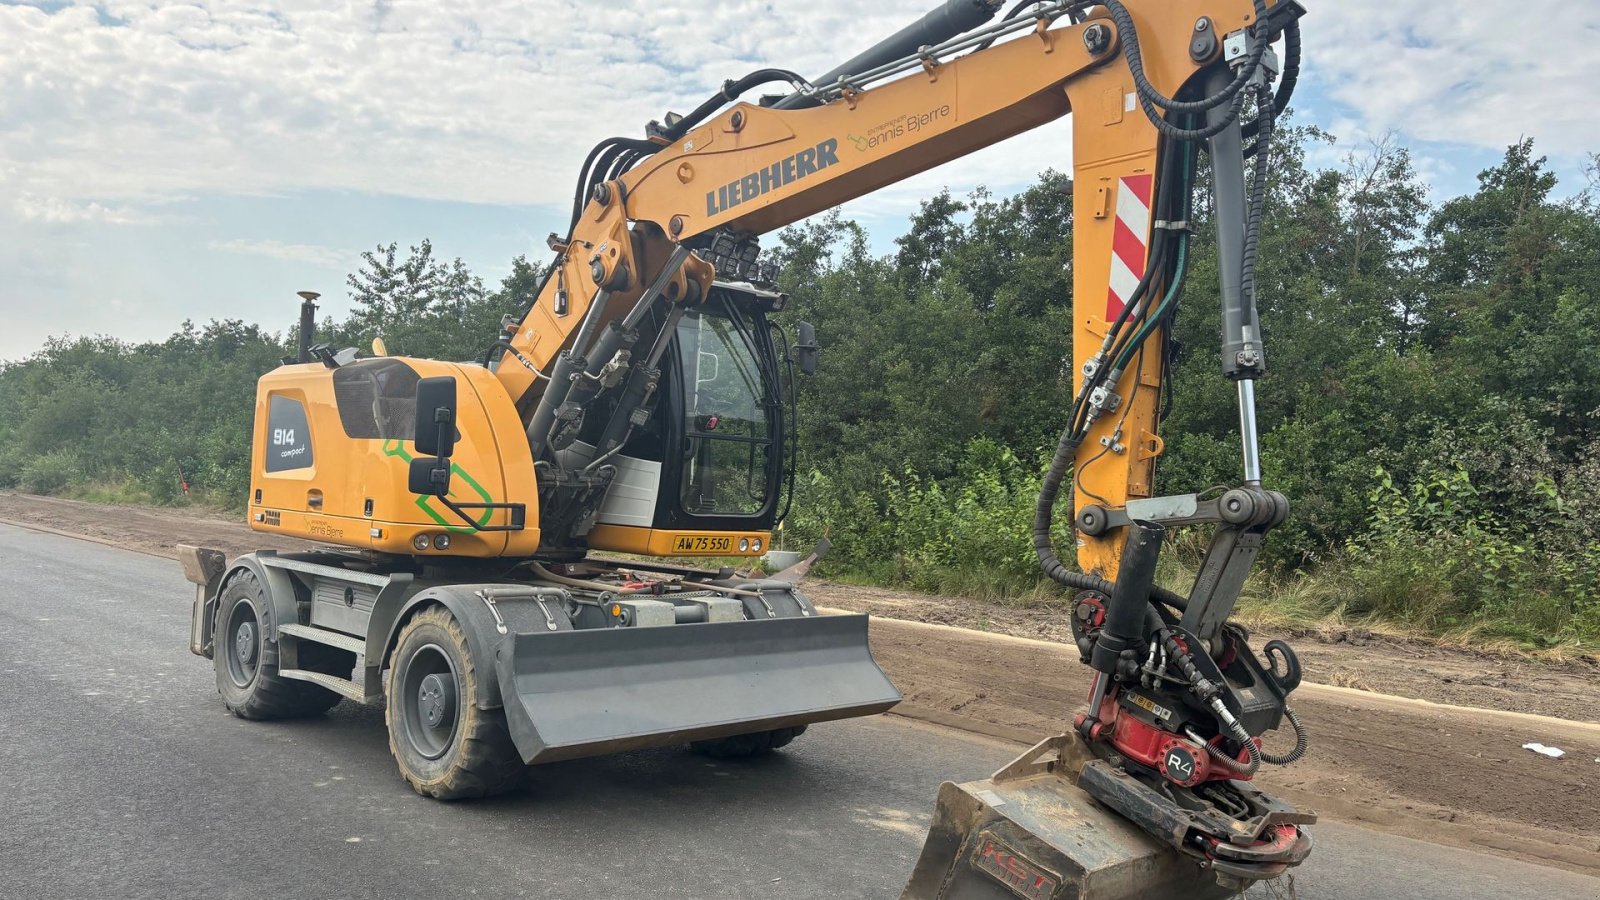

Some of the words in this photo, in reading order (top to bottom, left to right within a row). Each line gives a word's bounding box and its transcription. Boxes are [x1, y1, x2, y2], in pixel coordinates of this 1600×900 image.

[907, 105, 950, 132] Bjerre
[706, 138, 840, 218] LIEBHERR
[273, 428, 295, 445] 914
[281, 443, 305, 458] compact
[677, 537, 694, 550] AW
[695, 537, 709, 550] 75
[709, 537, 730, 550] 550
[1167, 753, 1192, 776] R4
